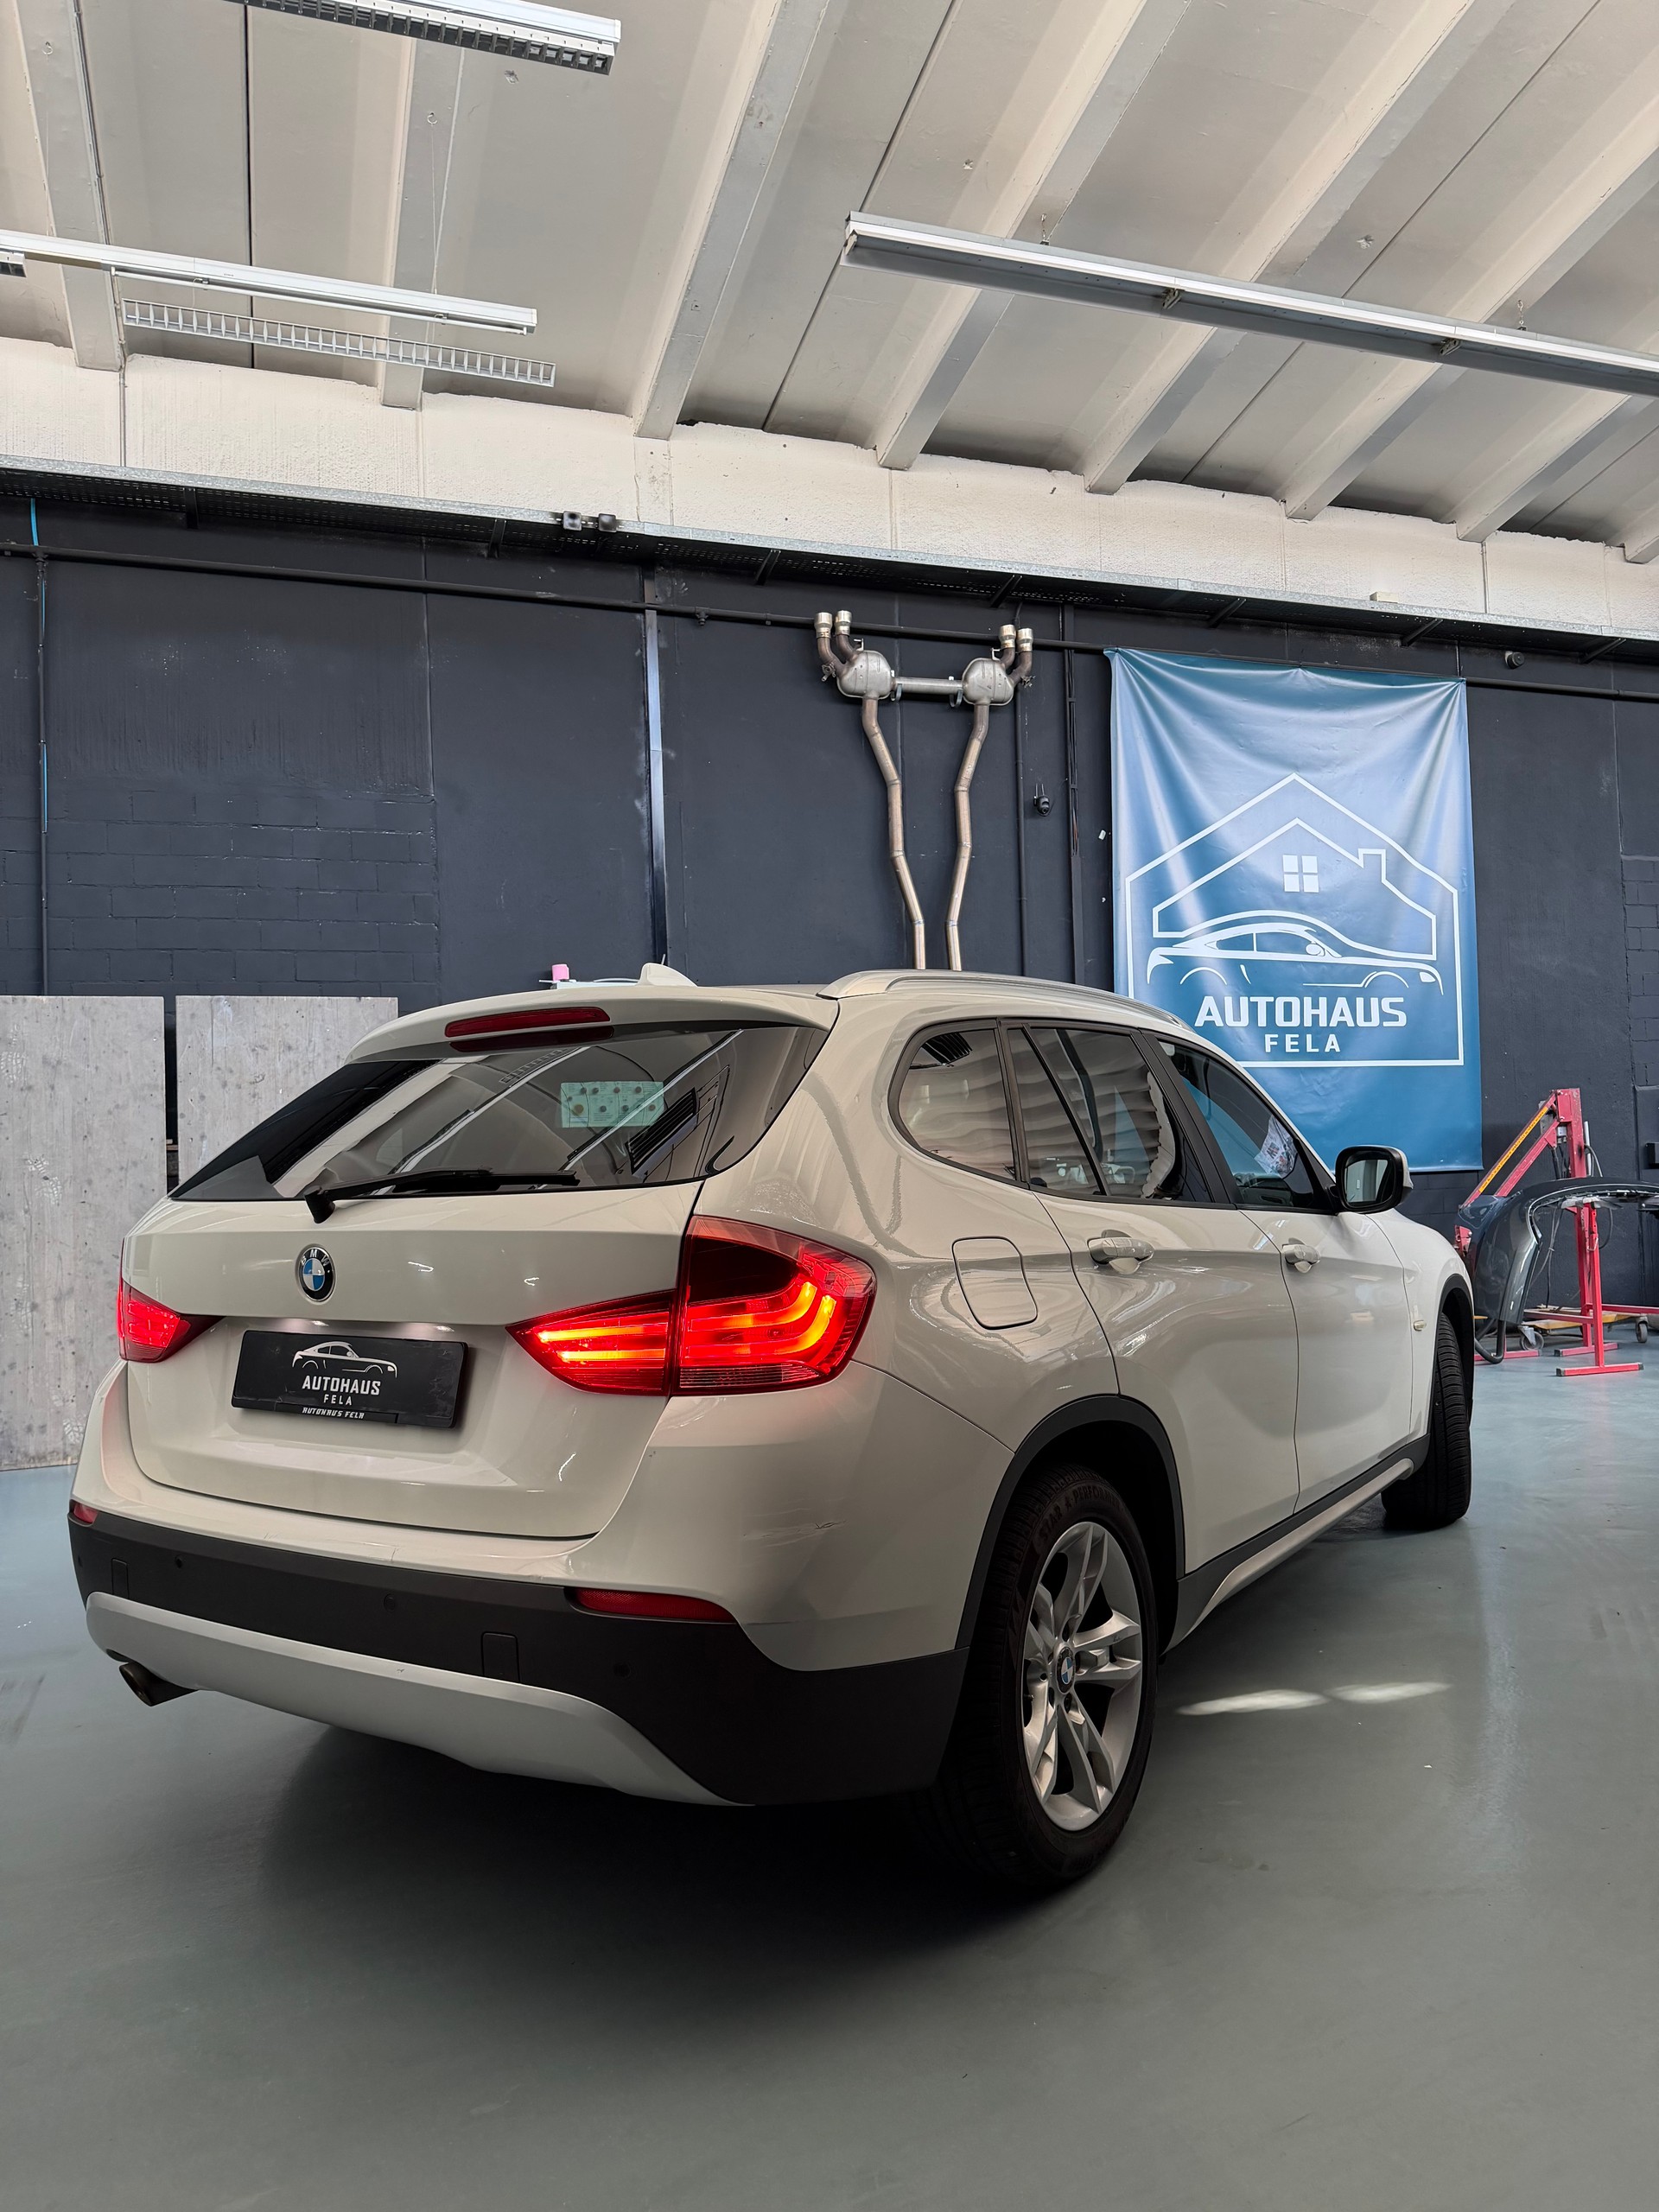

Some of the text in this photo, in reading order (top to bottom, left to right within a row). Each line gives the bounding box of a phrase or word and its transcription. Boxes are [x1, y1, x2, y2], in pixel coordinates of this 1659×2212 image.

[1194, 995, 1407, 1027] AUTOHAUS
[1264, 1033, 1340, 1052] FELA
[302, 1375, 381, 1395] AUTOHAUS
[323, 1394, 352, 1406] FELA
[302, 1407, 365, 1420] AUTOHAUS FELA
